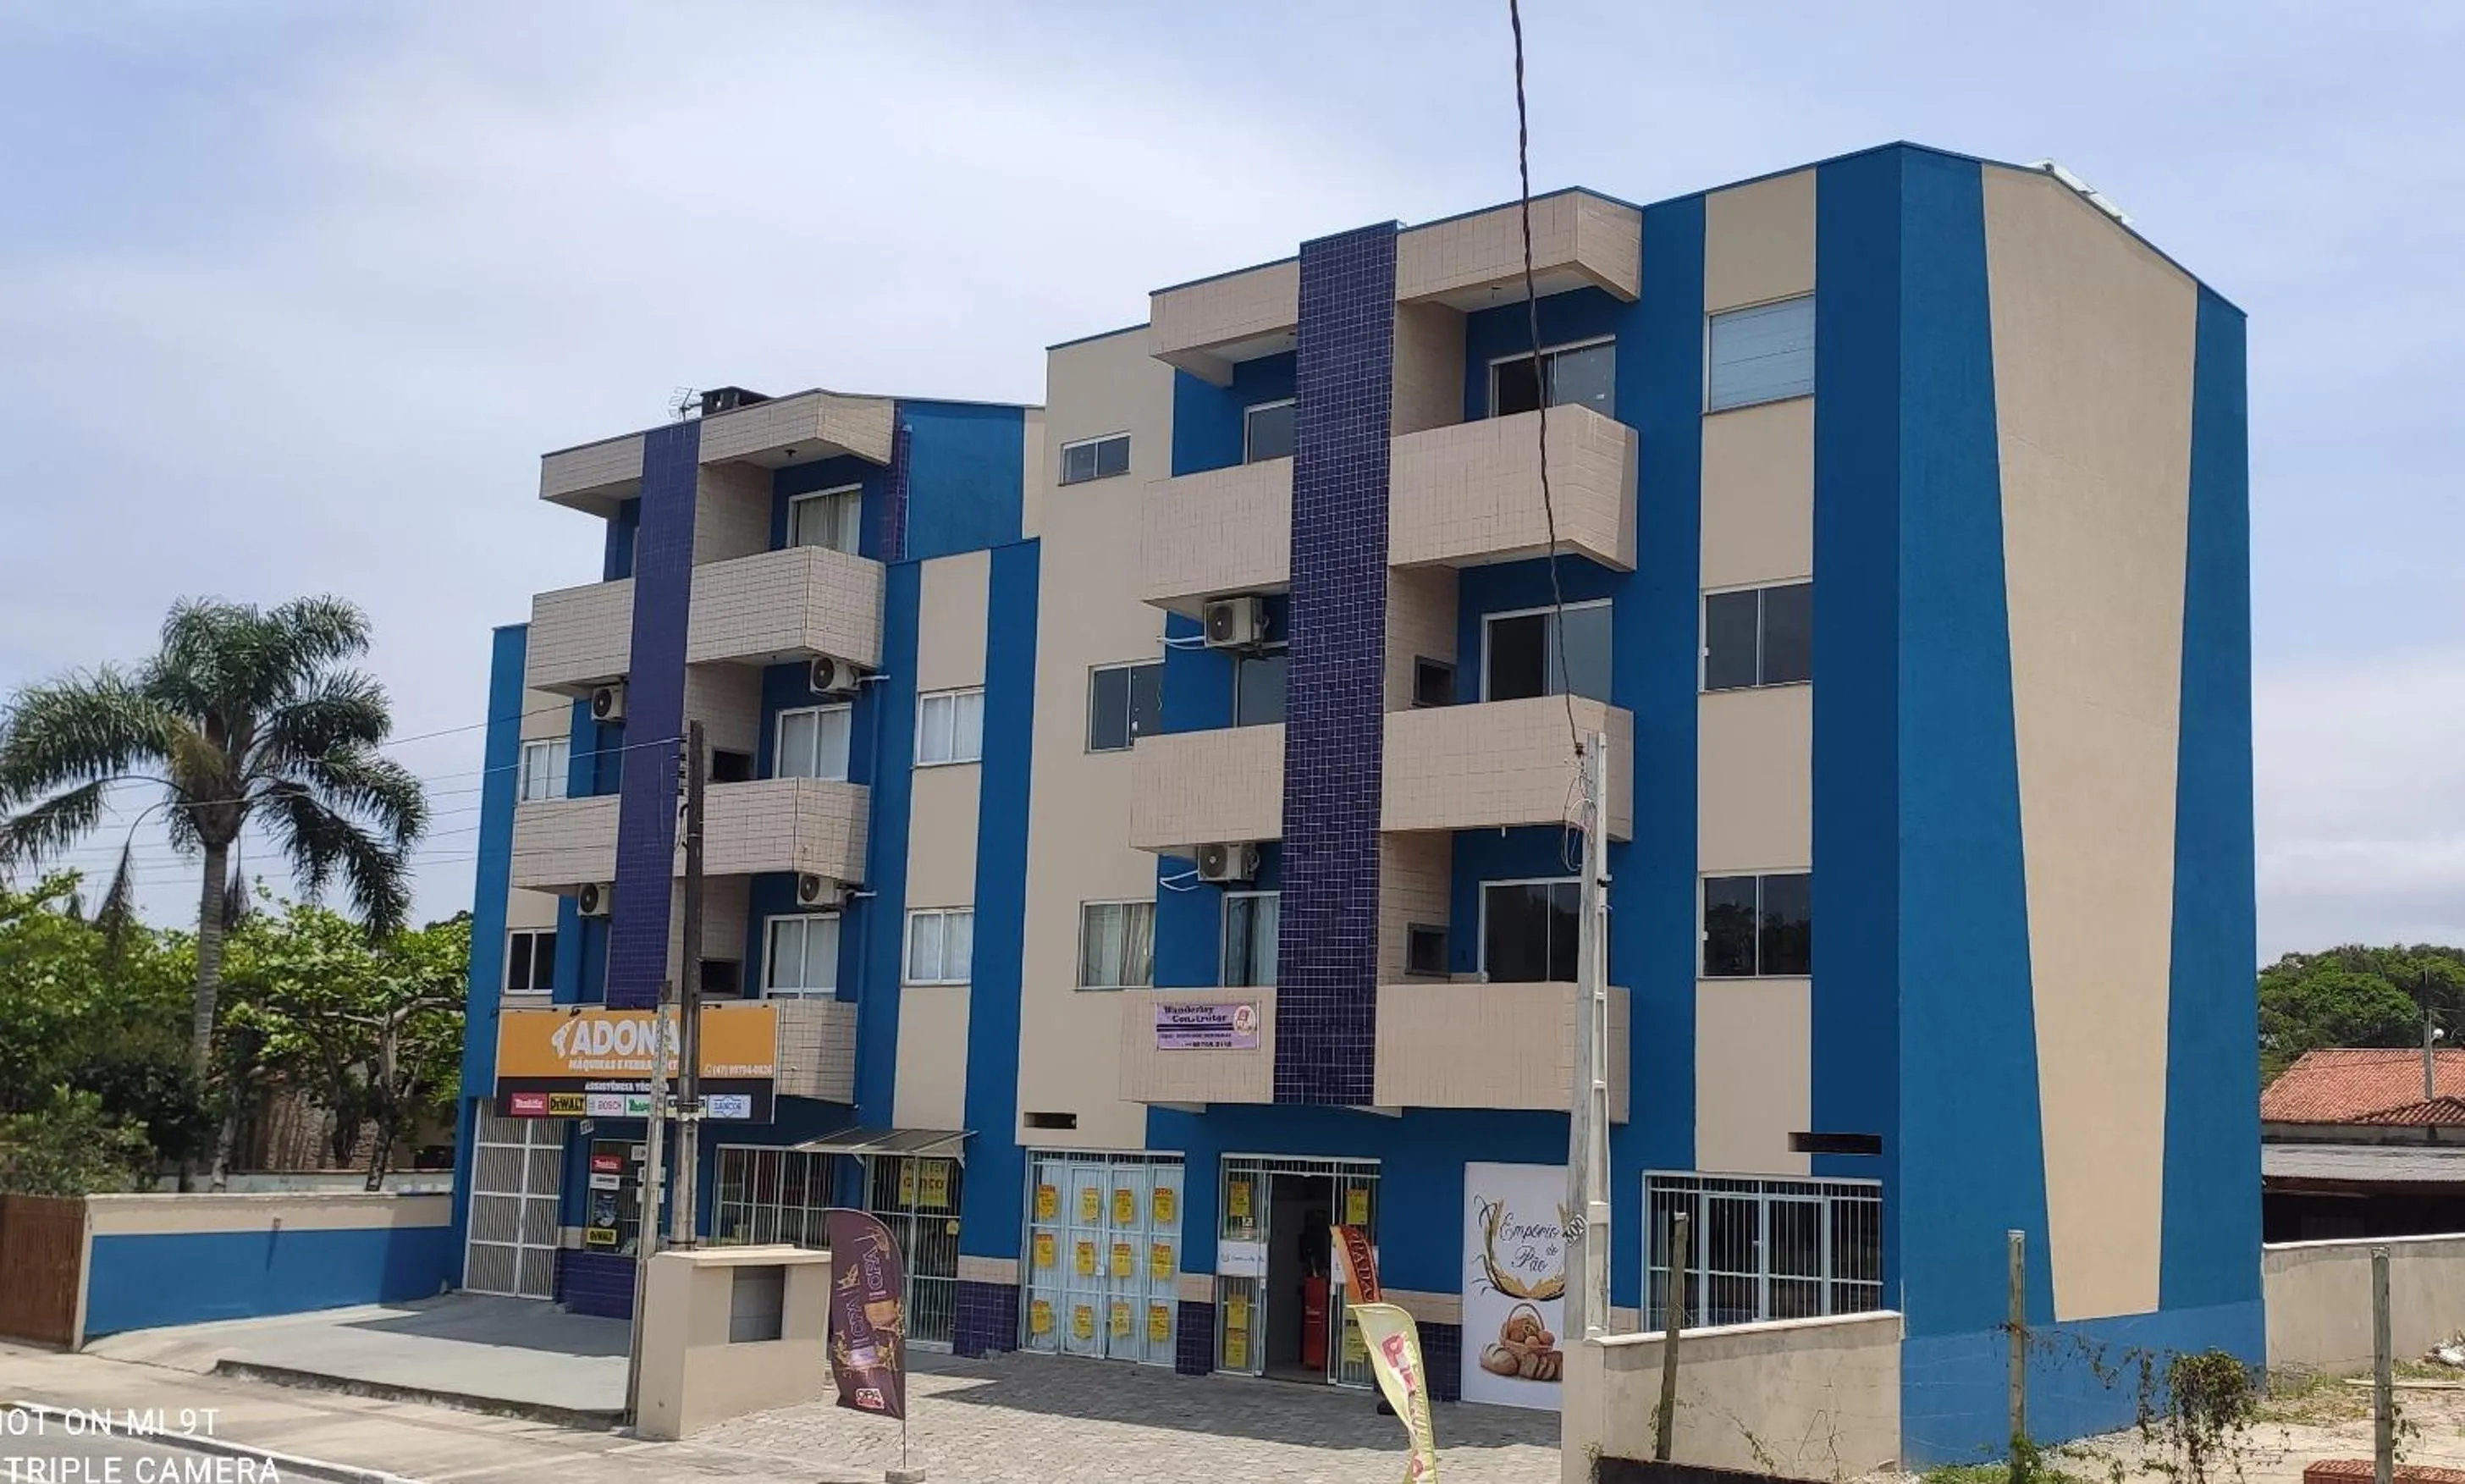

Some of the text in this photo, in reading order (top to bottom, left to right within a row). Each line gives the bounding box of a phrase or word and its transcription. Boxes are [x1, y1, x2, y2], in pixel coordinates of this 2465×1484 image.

[569, 1057, 615, 1072] MÁQUINAS
[585, 1080, 670, 1091] ASSISTÊNCIA TÉCA
[514, 1099, 543, 1108] Makita
[598, 1101, 622, 1110] BOSCH
